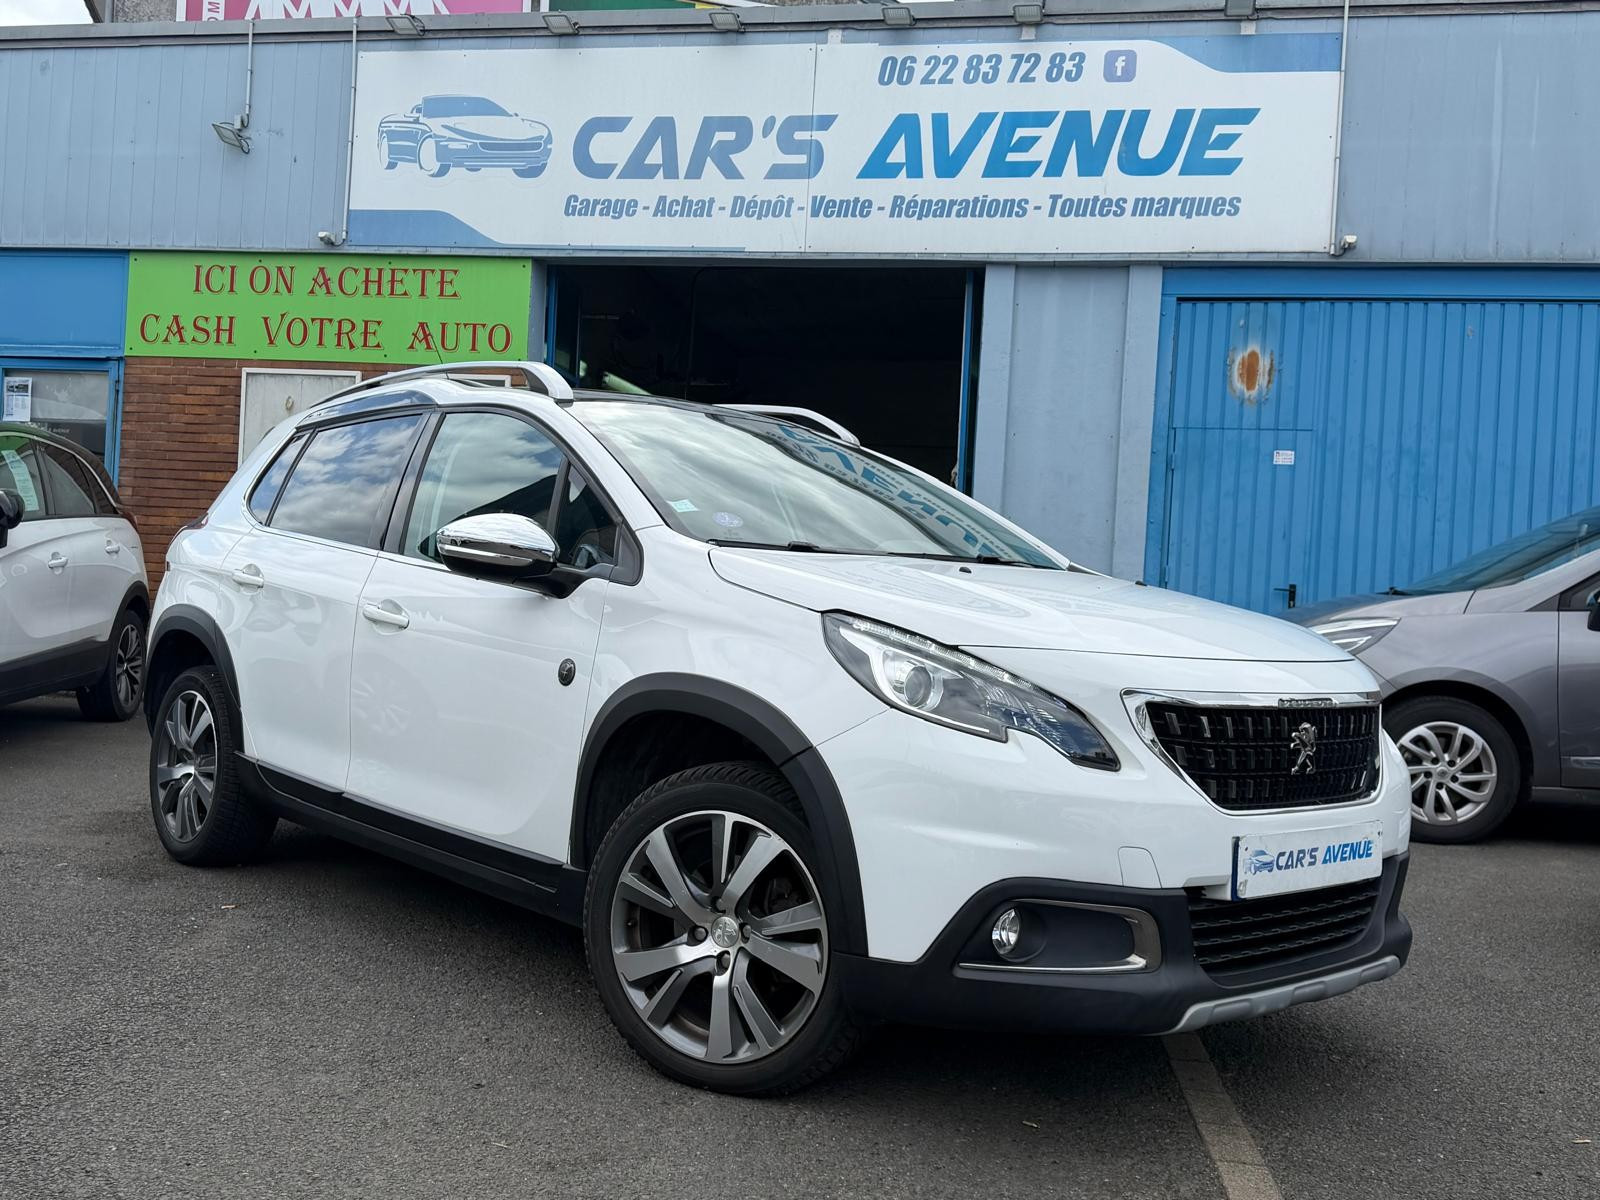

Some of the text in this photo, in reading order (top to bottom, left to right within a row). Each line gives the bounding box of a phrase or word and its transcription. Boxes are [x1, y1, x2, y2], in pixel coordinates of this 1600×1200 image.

[877, 51, 1087, 86] 06 22 83 72 83
[572, 107, 1262, 180] CAR'S AVENUE
[563, 193, 639, 219] Garage
[652, 194, 716, 219] Achat
[729, 194, 795, 221] Dépôt
[809, 194, 874, 219] Vente
[888, 193, 1030, 221] Réparations
[1047, 193, 1127, 219] Toutes
[1130, 196, 1242, 221] marques
[193, 264, 461, 299] ICI ON ACHETE
[139, 311, 513, 354] CASH VOTRE AUTO
[1275, 839, 1374, 871] CAR'S AVENUE
